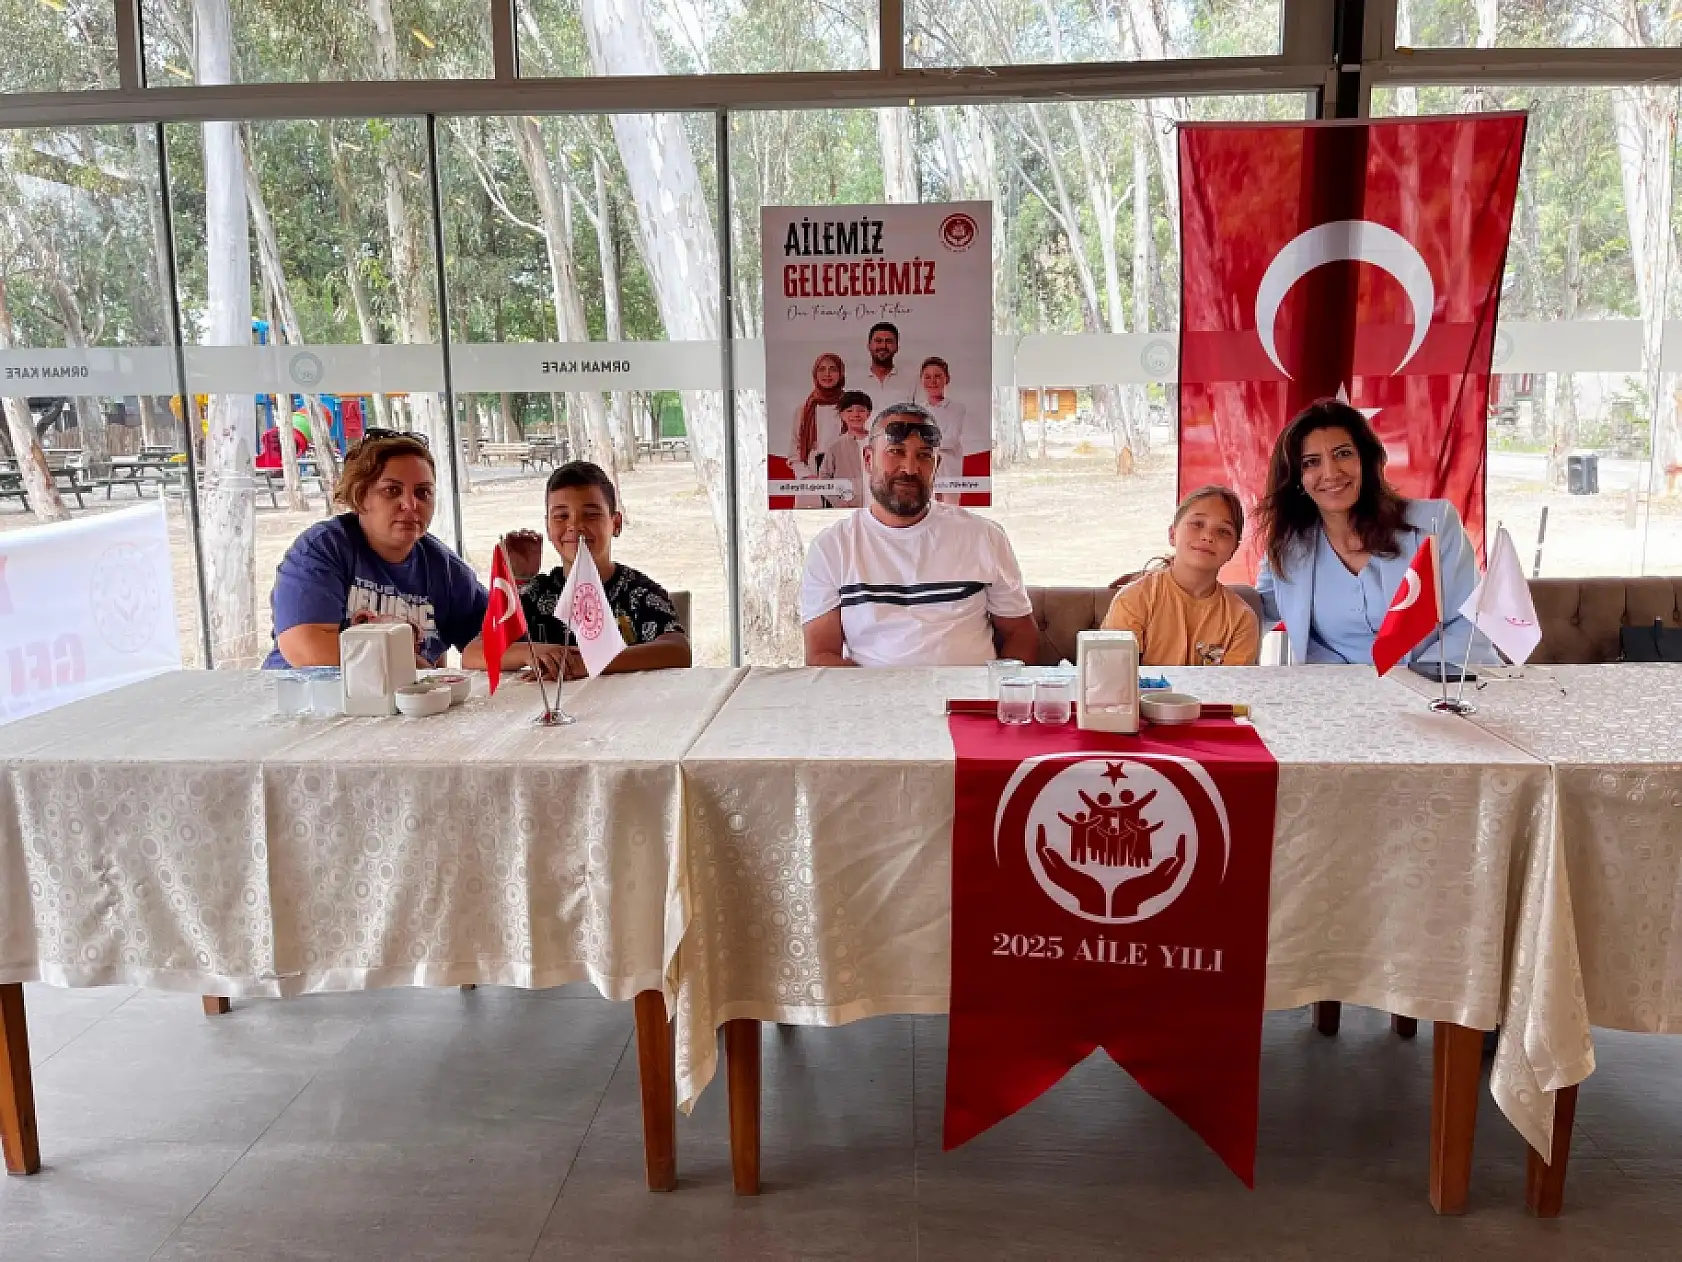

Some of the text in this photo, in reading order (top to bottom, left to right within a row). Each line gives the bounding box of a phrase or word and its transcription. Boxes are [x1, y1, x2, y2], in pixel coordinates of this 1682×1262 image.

[784, 217, 884, 256] AİLEMİZ
[784, 256, 936, 297] GELECEĞİMİZ
[992, 932, 1224, 972] 2025 AİLE YILI
